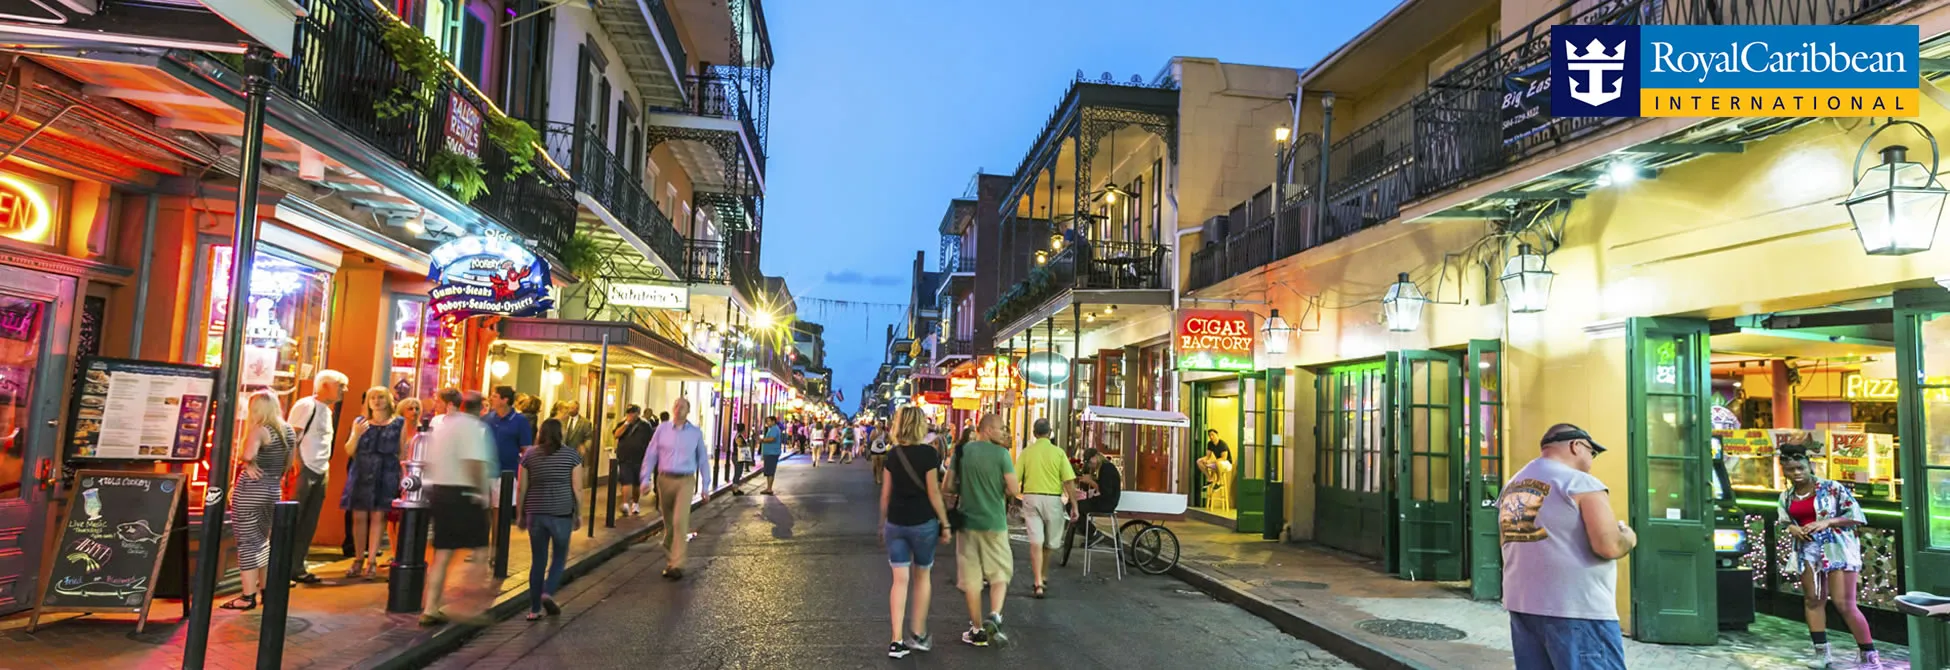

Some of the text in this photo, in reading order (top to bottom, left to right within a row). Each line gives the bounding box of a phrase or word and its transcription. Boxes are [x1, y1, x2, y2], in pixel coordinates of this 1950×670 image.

[1501, 77, 1551, 110] Big Eas
[450, 114, 479, 149] RENTALS
[484, 228, 513, 241] Olde
[503, 297, 533, 312] Oysters
[1186, 317, 1249, 336] CIGAR
[1181, 335, 1253, 351] FACTORY
[69, 520, 108, 528] Live Music
[64, 576, 82, 585] Fried
